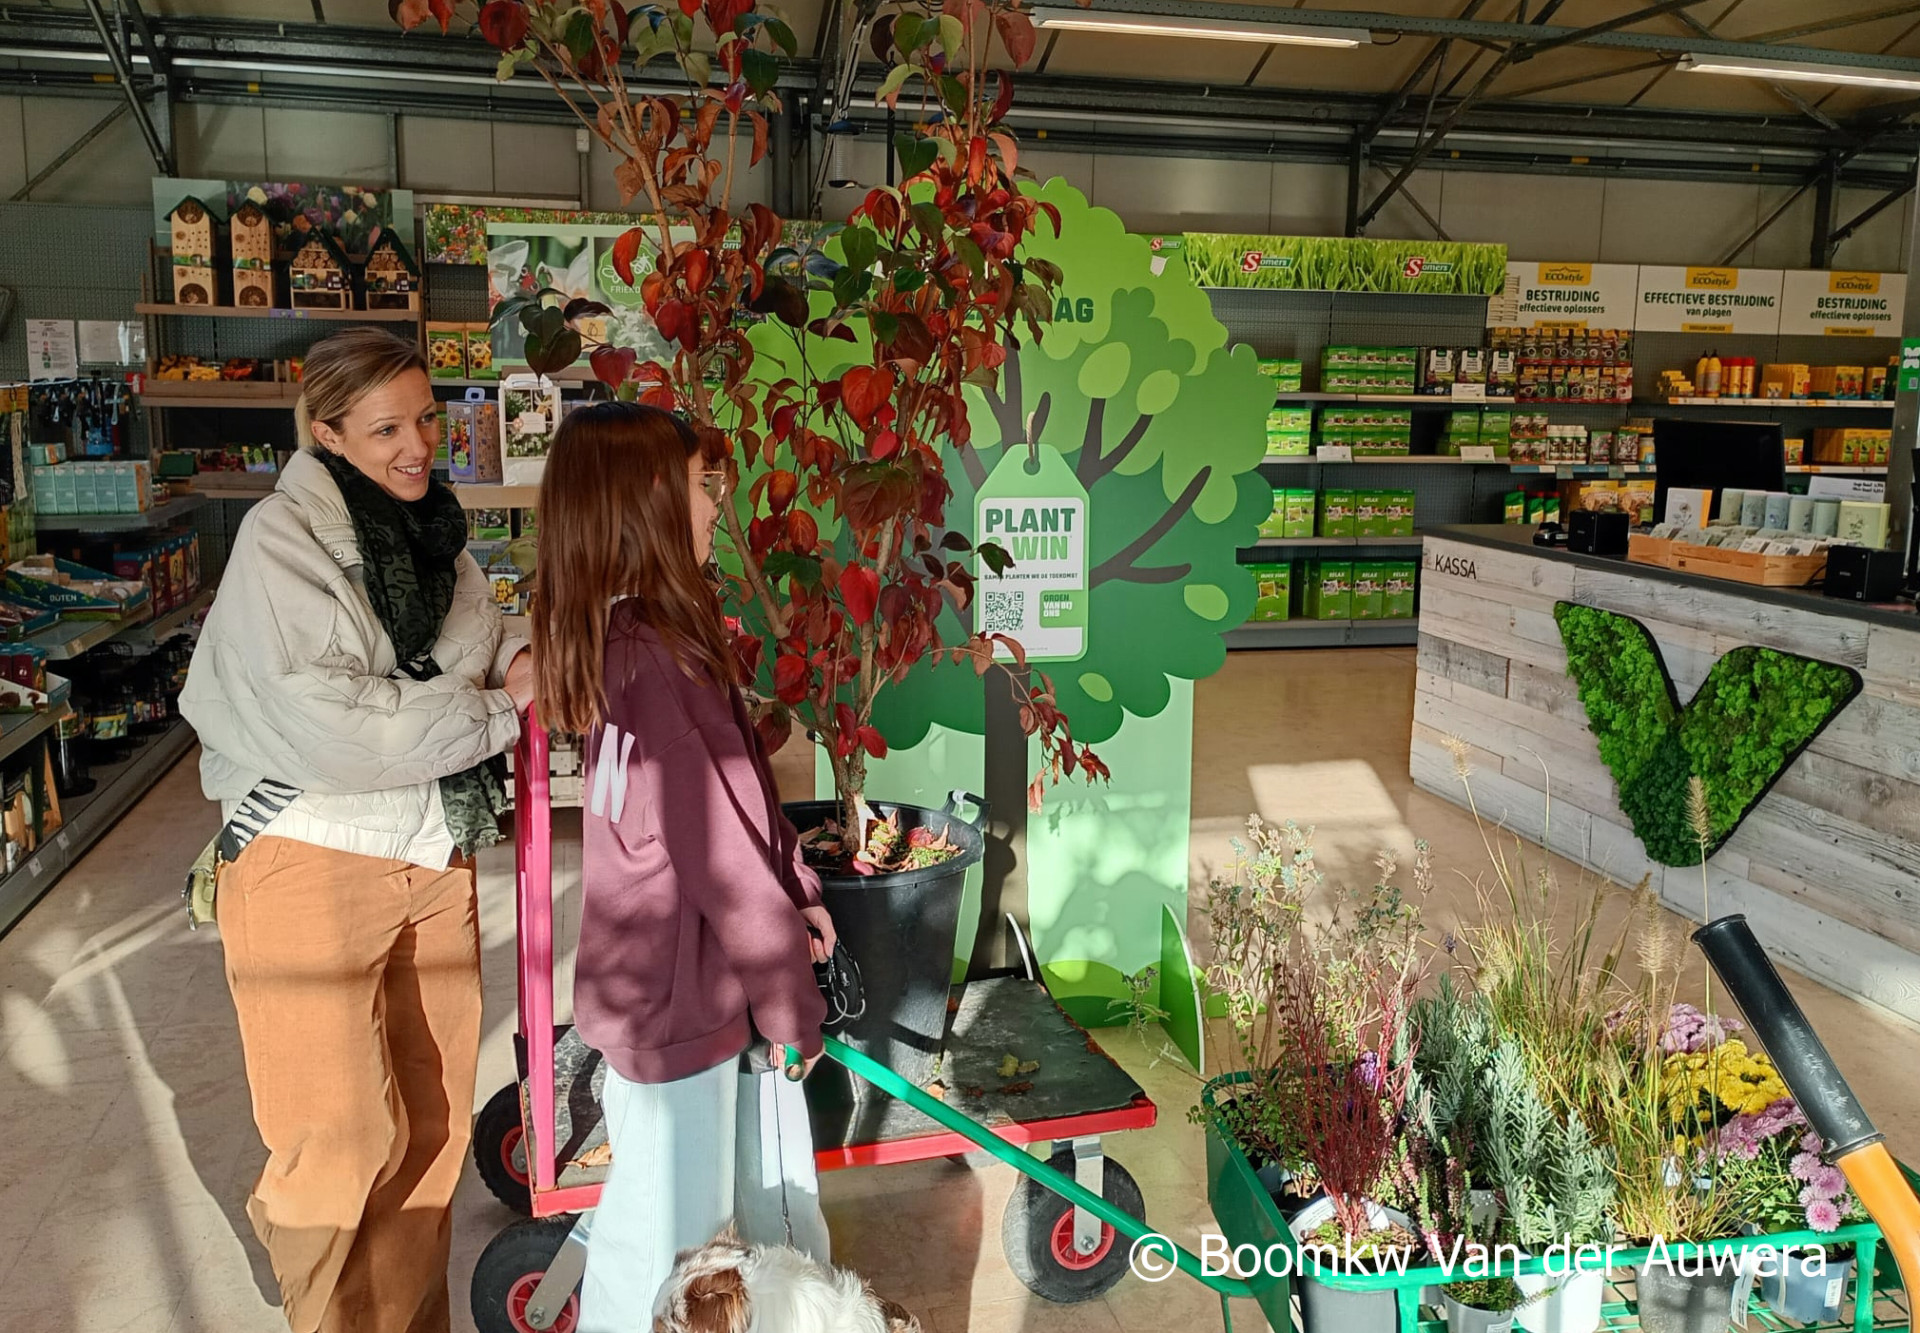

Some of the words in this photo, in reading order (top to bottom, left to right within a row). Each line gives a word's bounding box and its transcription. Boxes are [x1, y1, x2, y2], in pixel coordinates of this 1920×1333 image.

[1242, 252, 1290, 273] Somers
[1405, 257, 1450, 278] Somers
[1545, 272, 1584, 284] ECOstyle
[1692, 276, 1731, 287] ECOstyle
[1836, 281, 1873, 291] ECOstyle
[1526, 289, 1600, 303] BESTRIJDING
[1644, 292, 1705, 305] EFFECTIEVE
[1708, 294, 1775, 307] BESTRIJDING
[1519, 303, 1562, 313] effectieve
[1563, 304, 1605, 315] oplossers
[1817, 297, 1887, 310] BESTRIJDING
[1686, 308, 1701, 316] van
[1702, 307, 1732, 318] plagen
[1810, 310, 1851, 320] effectieve
[1853, 311, 1892, 322] oplossers
[985, 508, 1076, 533] PLANT
[1012, 535, 1068, 560] WIN
[1435, 553, 1477, 580] KASSA
